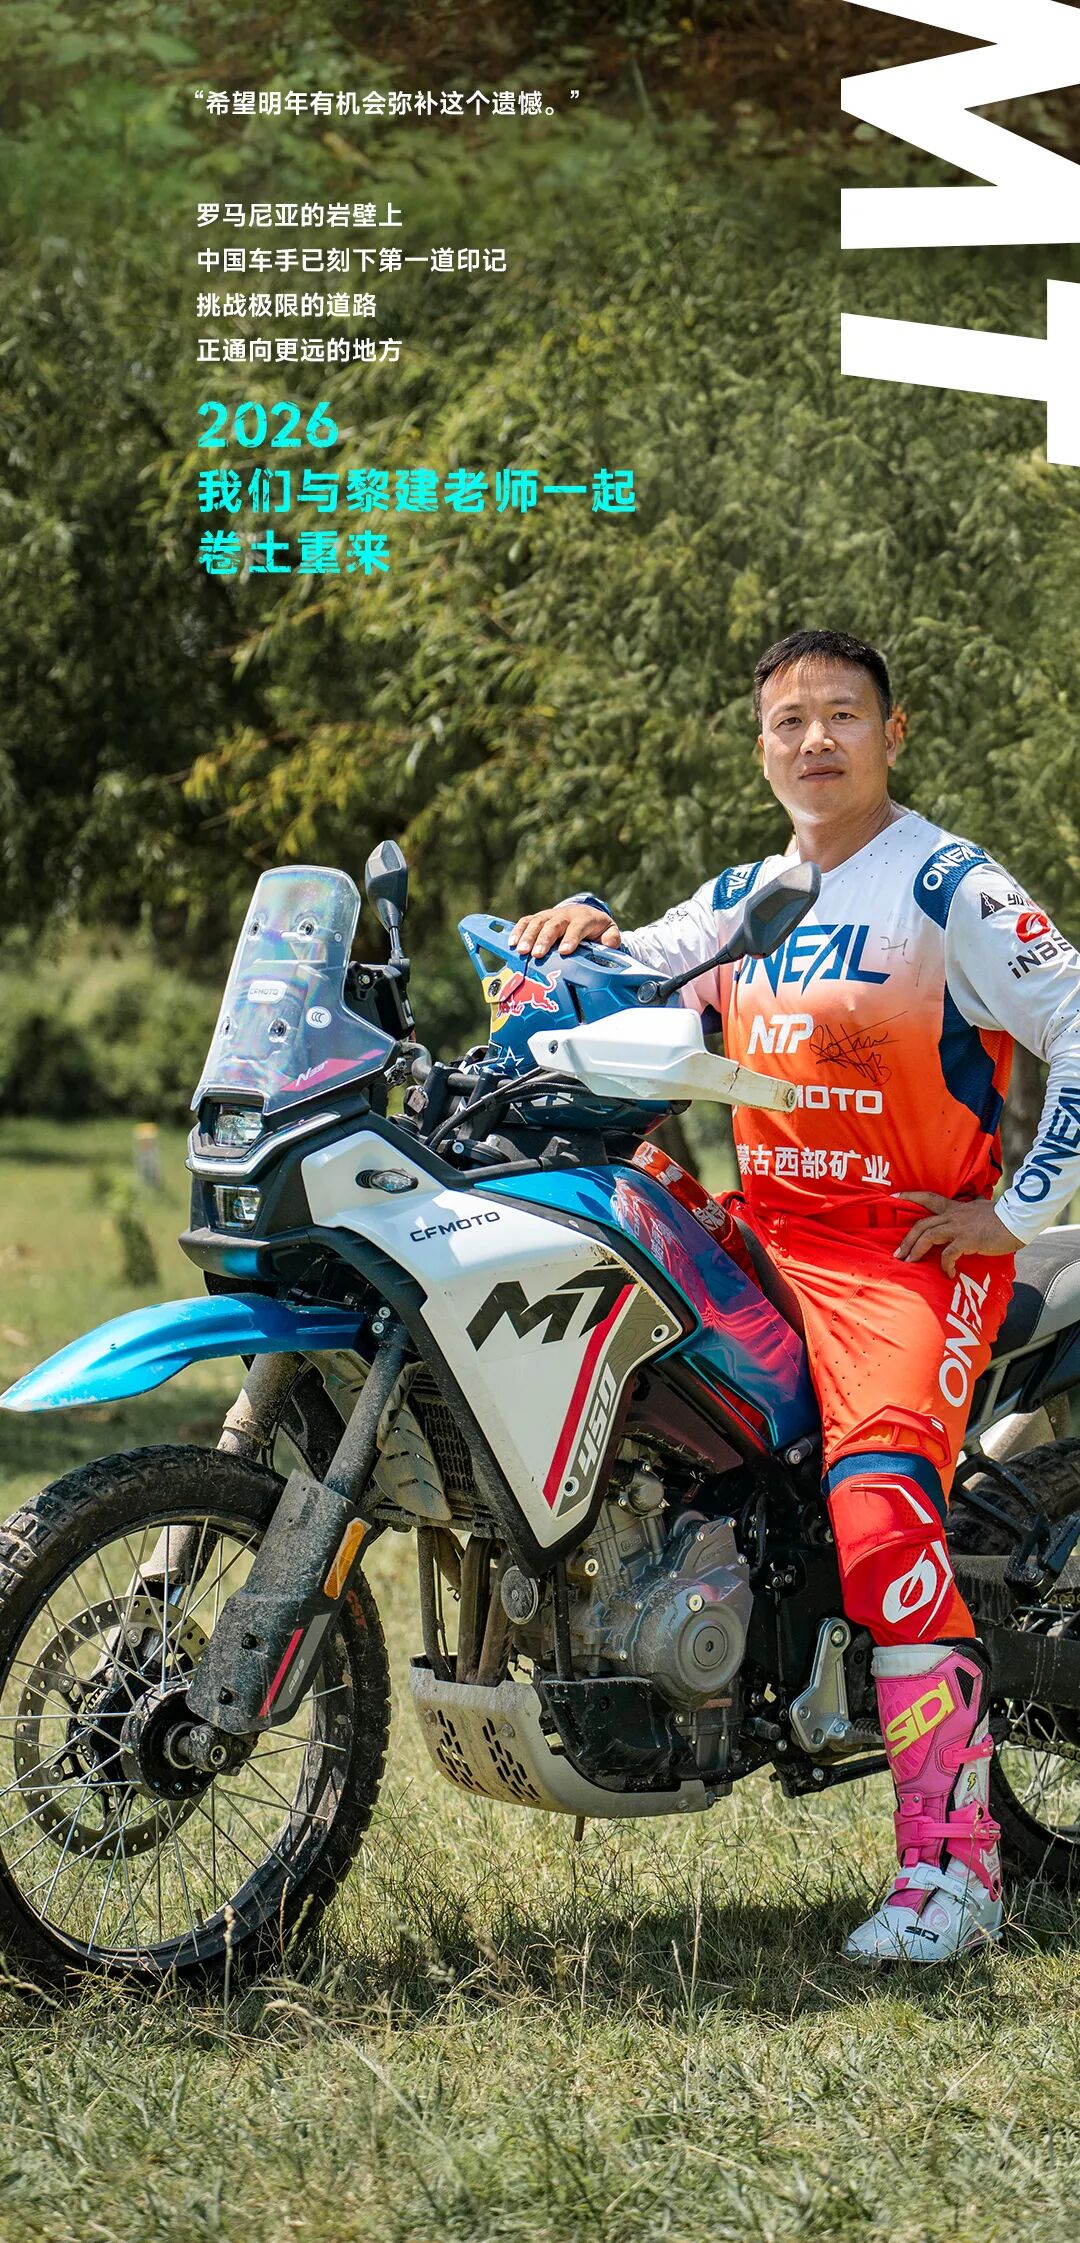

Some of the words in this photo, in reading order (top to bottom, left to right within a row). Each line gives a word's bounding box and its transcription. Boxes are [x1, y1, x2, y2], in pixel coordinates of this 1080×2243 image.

[735, 923, 891, 996] NEAL
[746, 1012, 814, 1055] NTP
[409, 1211, 501, 1242] CFMOTO
[577, 1361, 618, 1478] 450
[886, 1679, 956, 1759] SIDI
